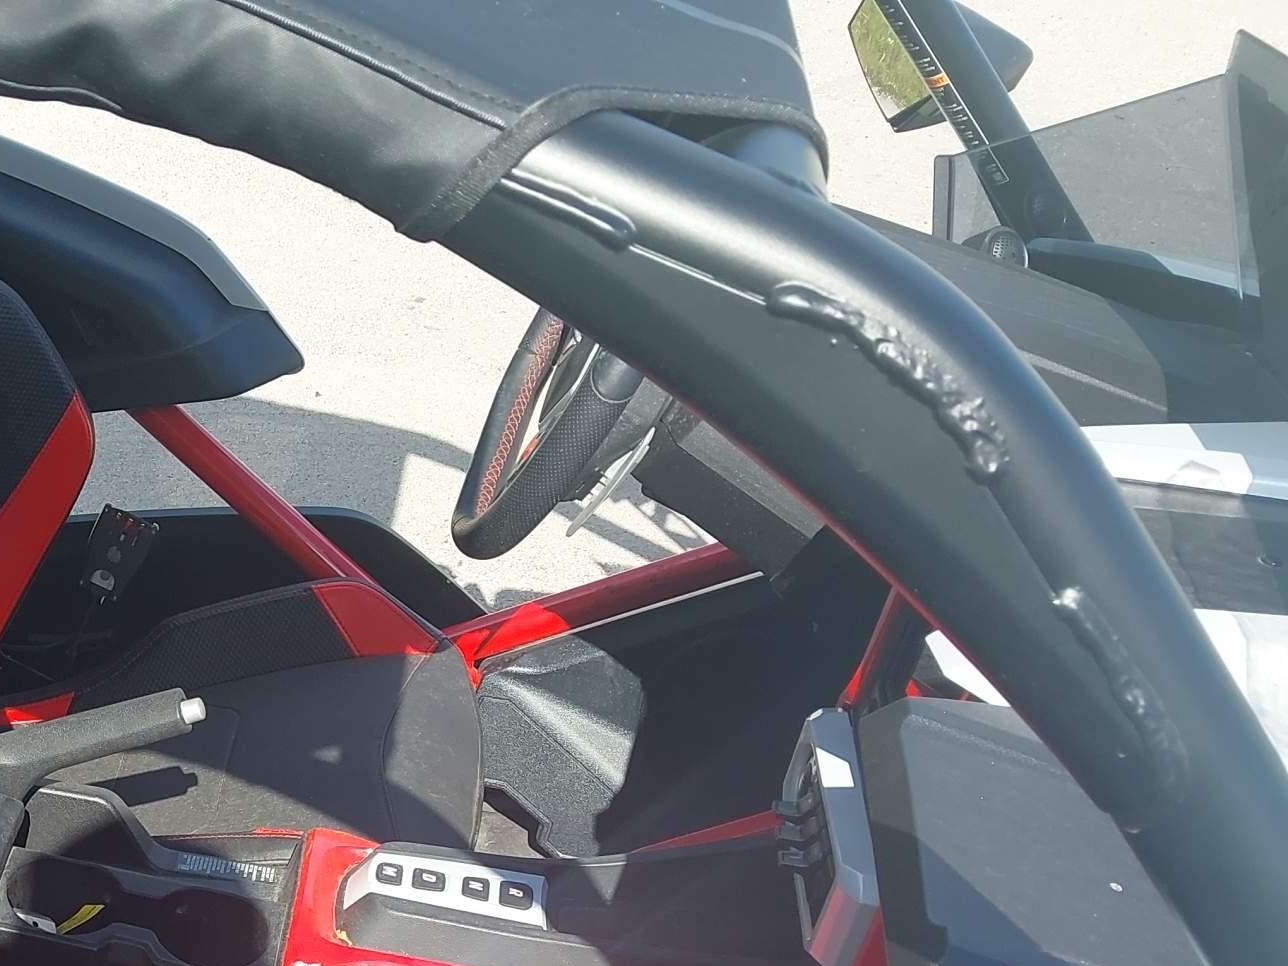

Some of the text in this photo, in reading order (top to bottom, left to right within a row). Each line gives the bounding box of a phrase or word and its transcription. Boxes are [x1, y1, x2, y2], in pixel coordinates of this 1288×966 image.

[382, 865, 398, 877] M
[468, 880, 483, 891] N
[509, 887, 523, 898] R
